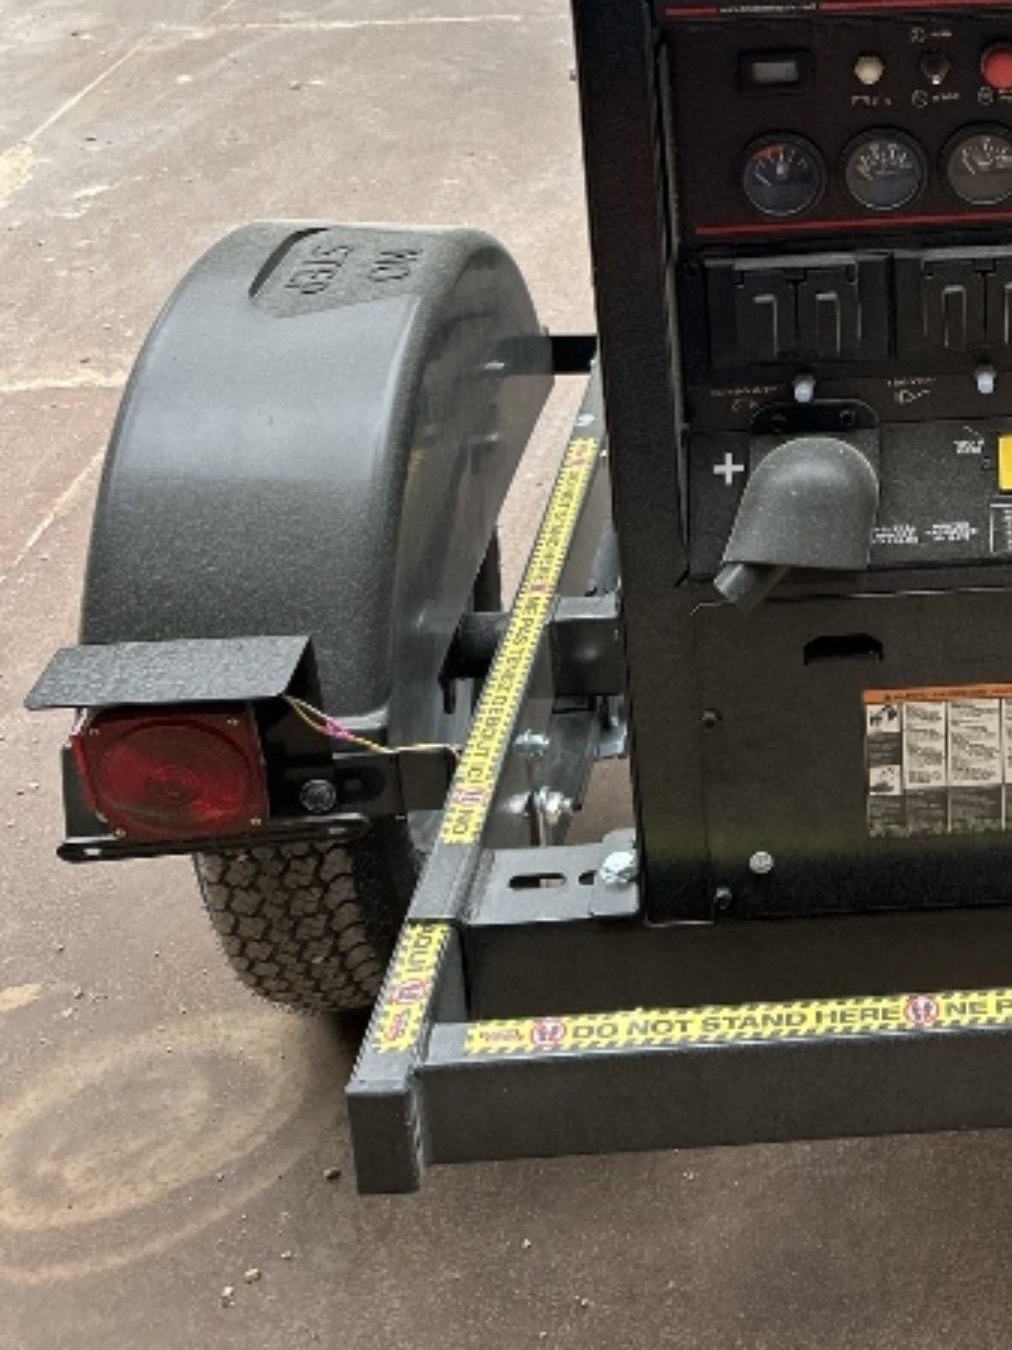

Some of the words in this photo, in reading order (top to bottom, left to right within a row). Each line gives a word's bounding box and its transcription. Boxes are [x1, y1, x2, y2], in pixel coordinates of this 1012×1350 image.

[571, 1022, 619, 1040] DO
[626, 1018, 699, 1037] NOT
[701, 1011, 807, 1033] STAND
[814, 1005, 902, 1026] HERE
[948, 1000, 989, 1016] NE
